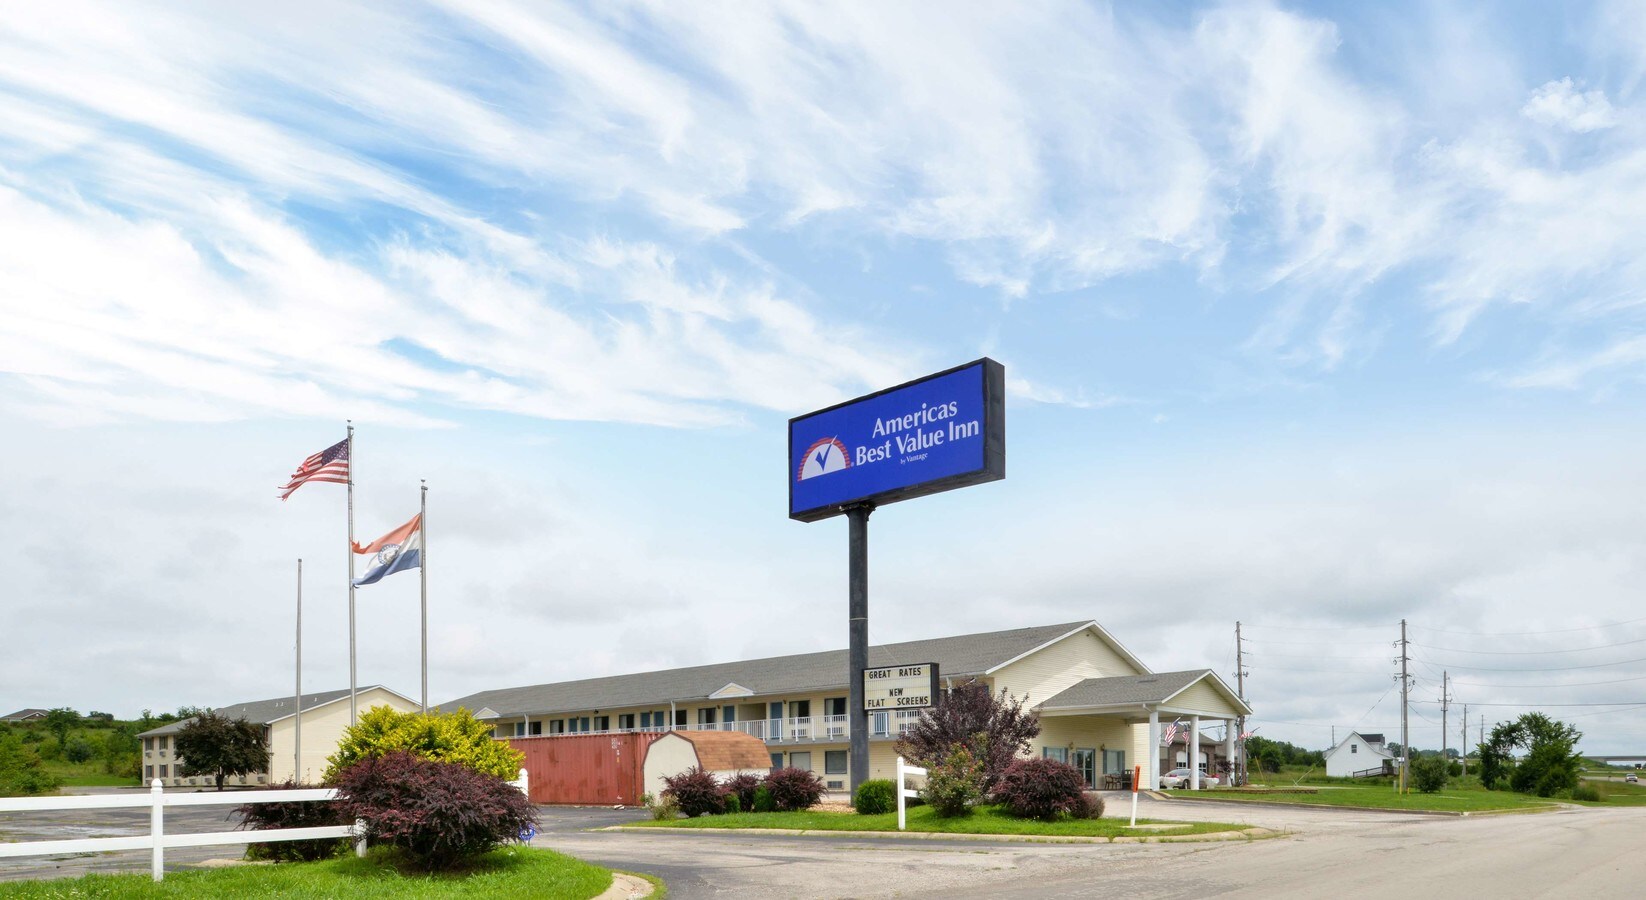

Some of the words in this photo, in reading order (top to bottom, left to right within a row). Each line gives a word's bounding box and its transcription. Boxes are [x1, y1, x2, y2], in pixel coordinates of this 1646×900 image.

[872, 400, 958, 439] Americas
[856, 440, 892, 466] Best
[895, 428, 945, 455] Value
[949, 419, 979, 441] Inn
[906, 452, 928, 463] Vantage
[869, 670, 891, 679] GREAT
[899, 667, 921, 677] RATES
[889, 688, 903, 697] NEW
[868, 699, 885, 707] FLAT
[897, 696, 928, 706] SCREENS
